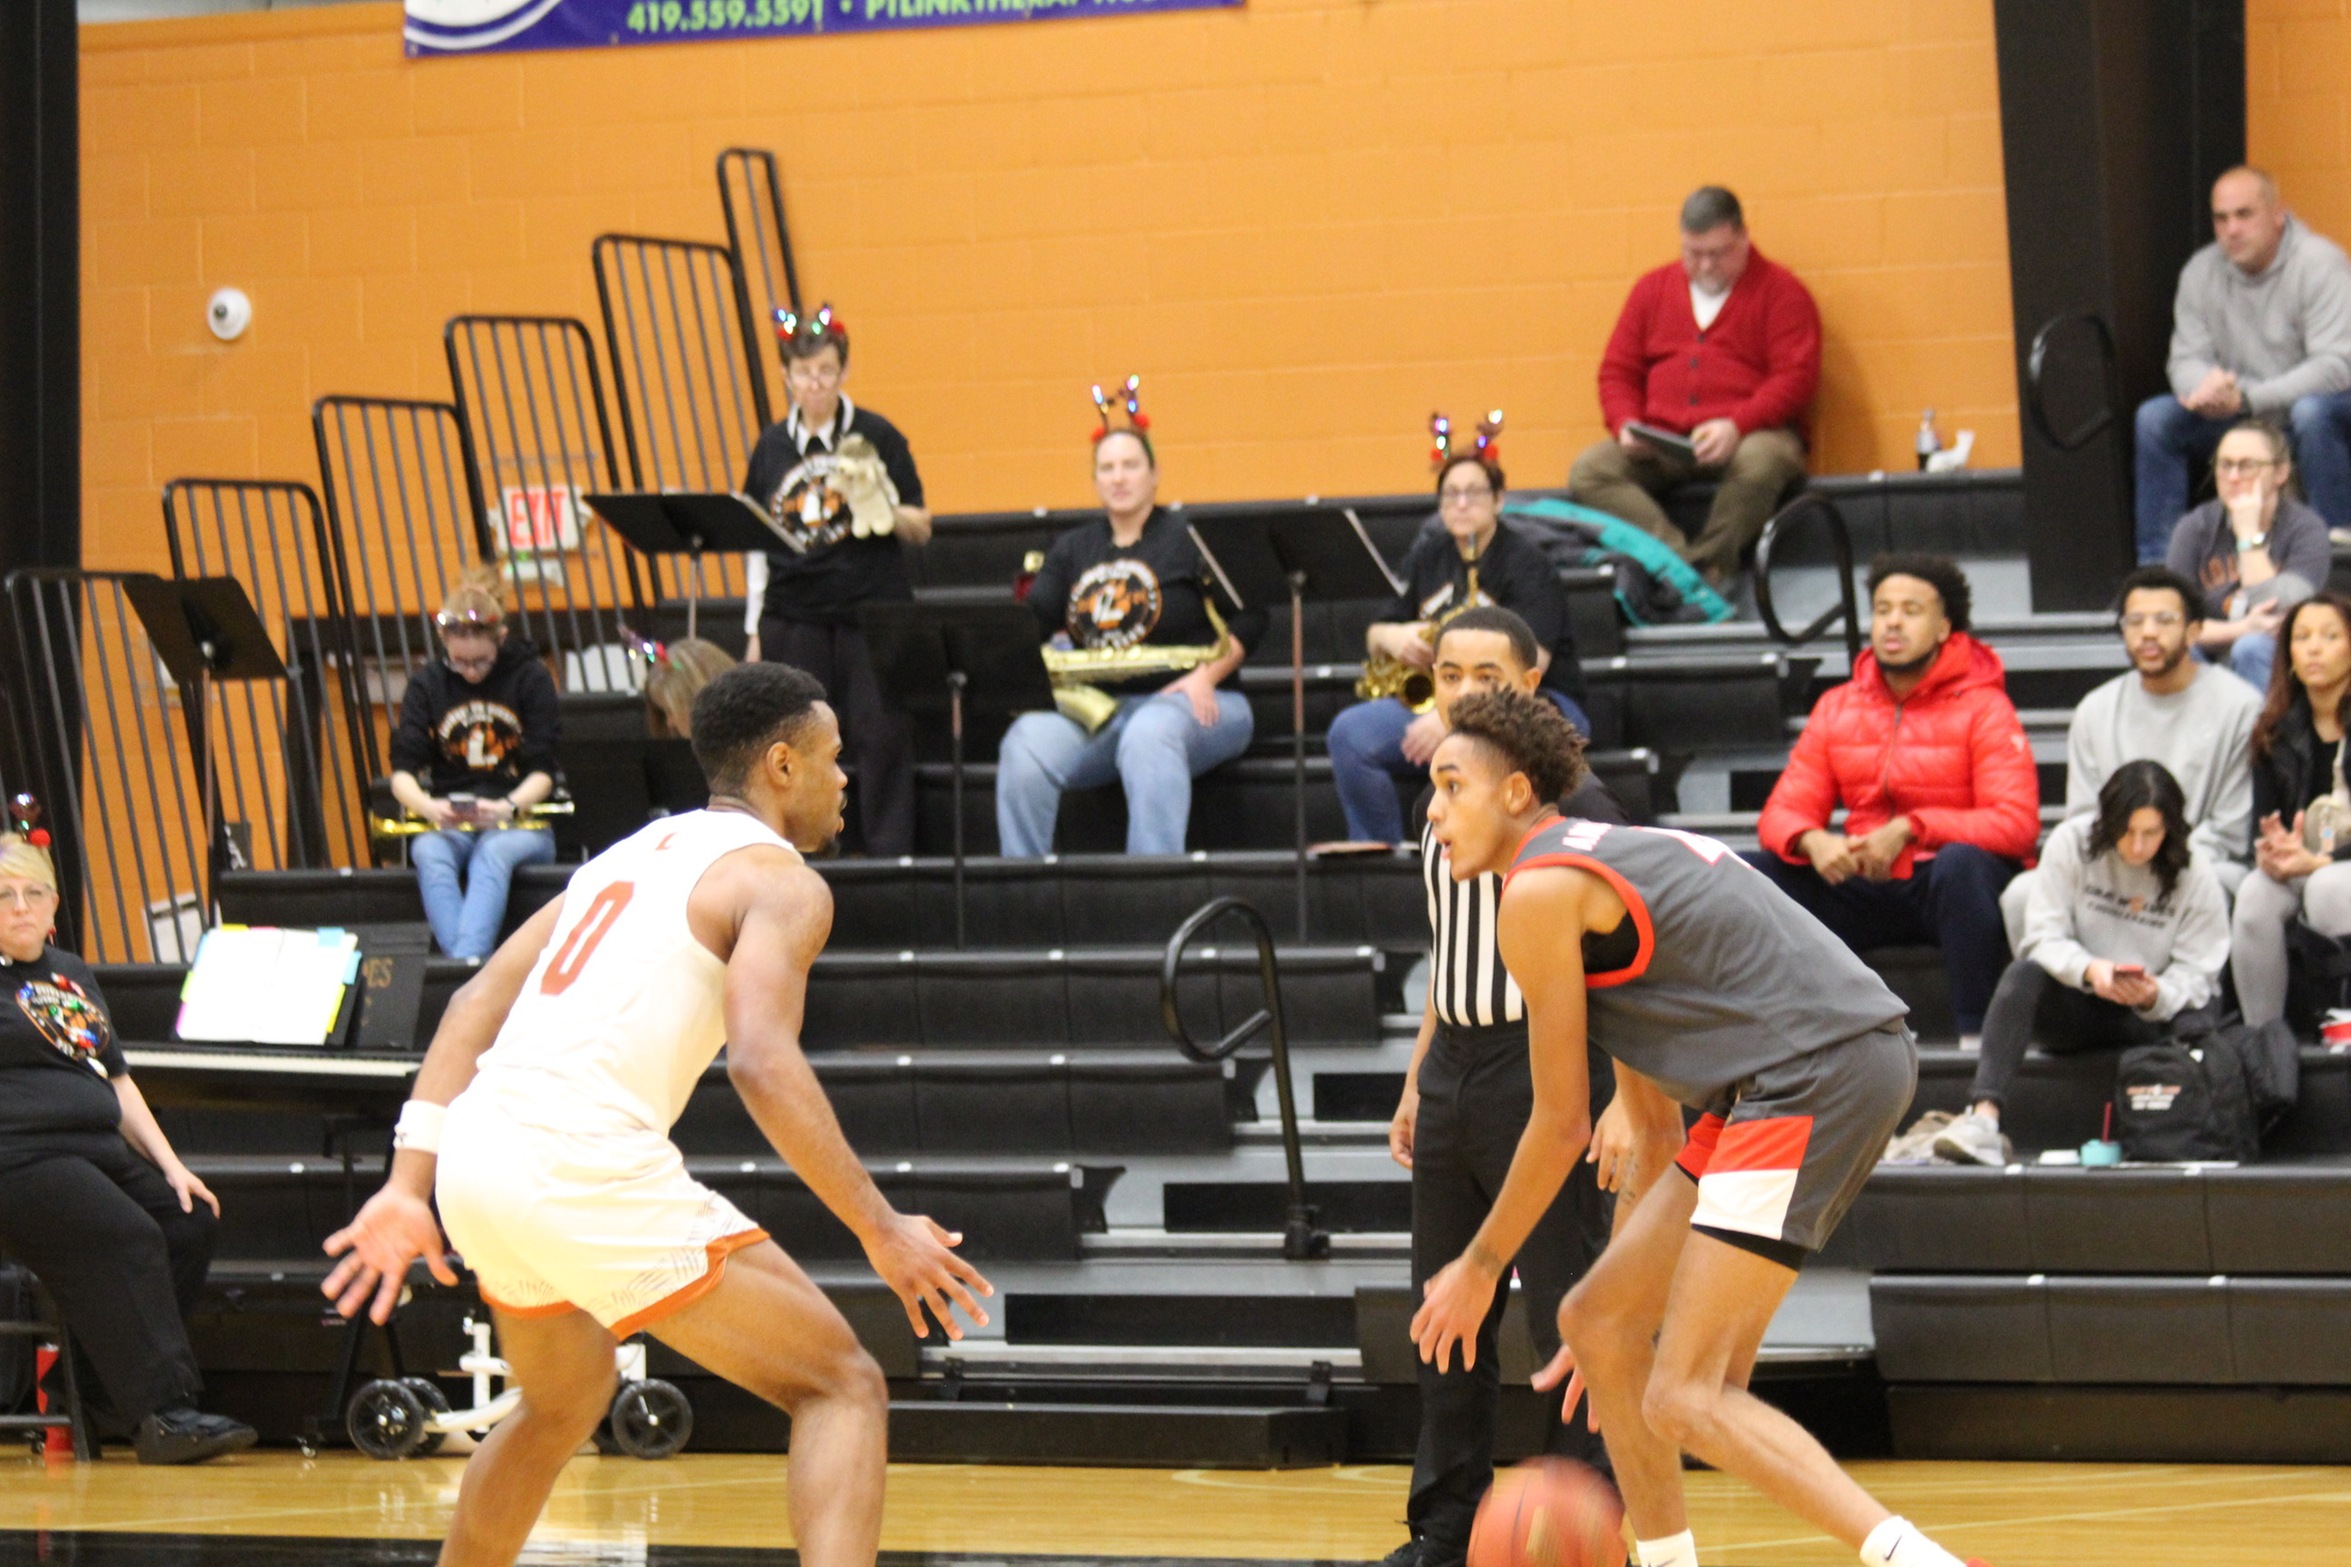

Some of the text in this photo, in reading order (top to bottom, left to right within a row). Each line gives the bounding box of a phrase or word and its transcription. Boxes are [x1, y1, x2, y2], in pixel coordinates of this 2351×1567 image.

[627, 0, 834, 33] 419.559.5591
[510, 492, 566, 547] EXIT
[538, 879, 636, 998] 0
